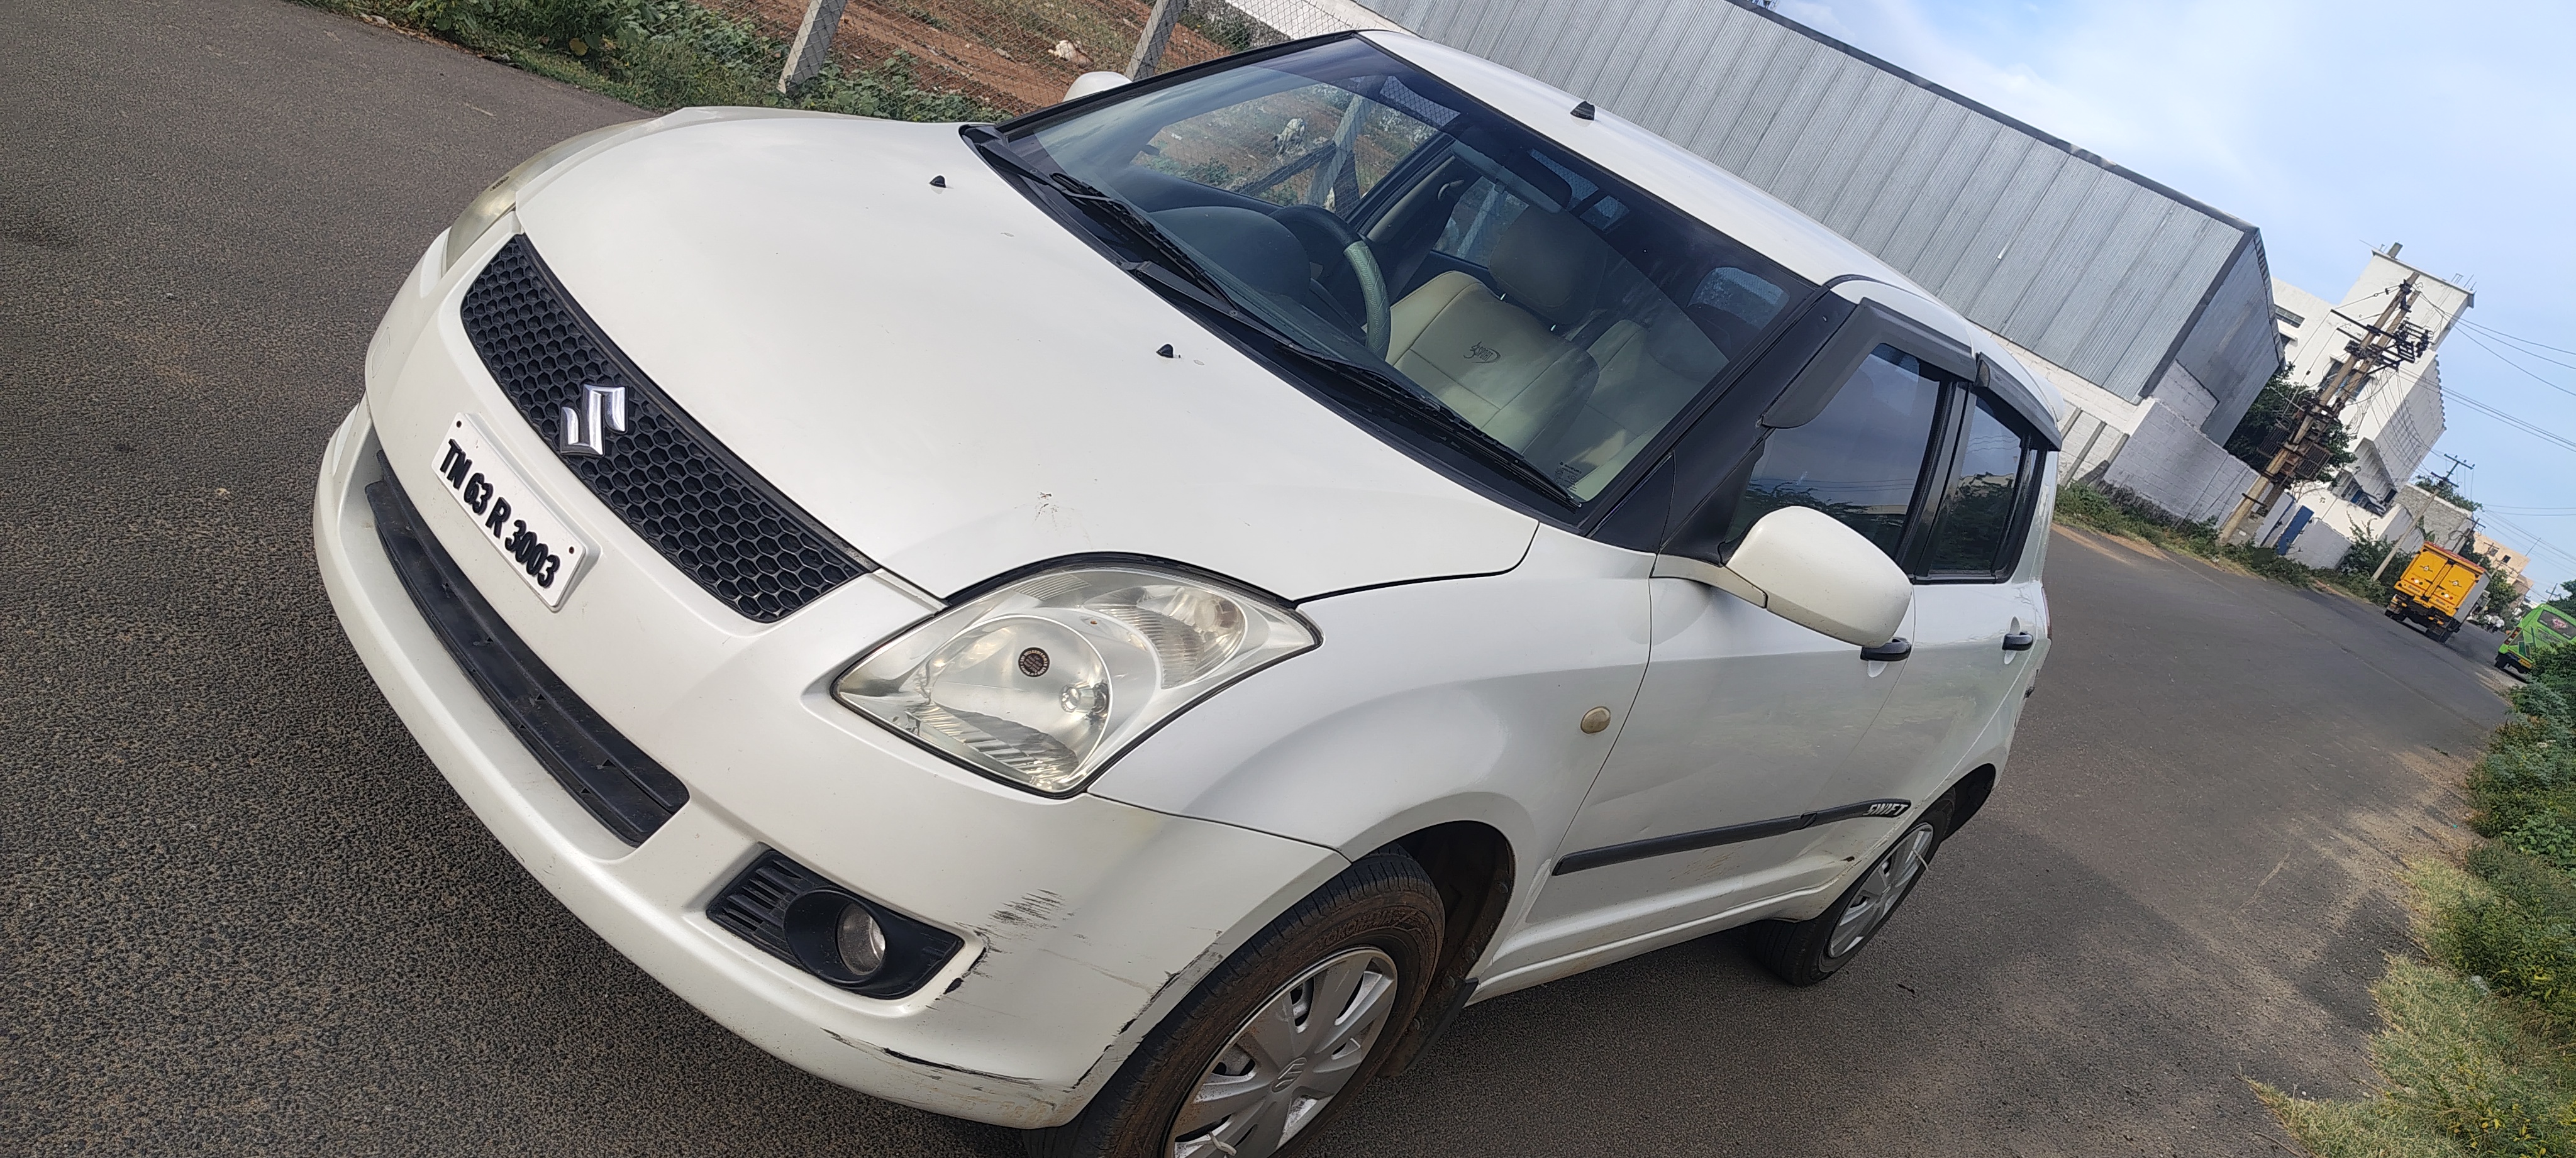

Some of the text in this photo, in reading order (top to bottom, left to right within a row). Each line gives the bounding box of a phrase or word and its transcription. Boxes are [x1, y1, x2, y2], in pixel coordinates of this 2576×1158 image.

[440, 439, 561, 588] TN 63 R 3003
[1862, 803, 1909, 815] SWIFT
